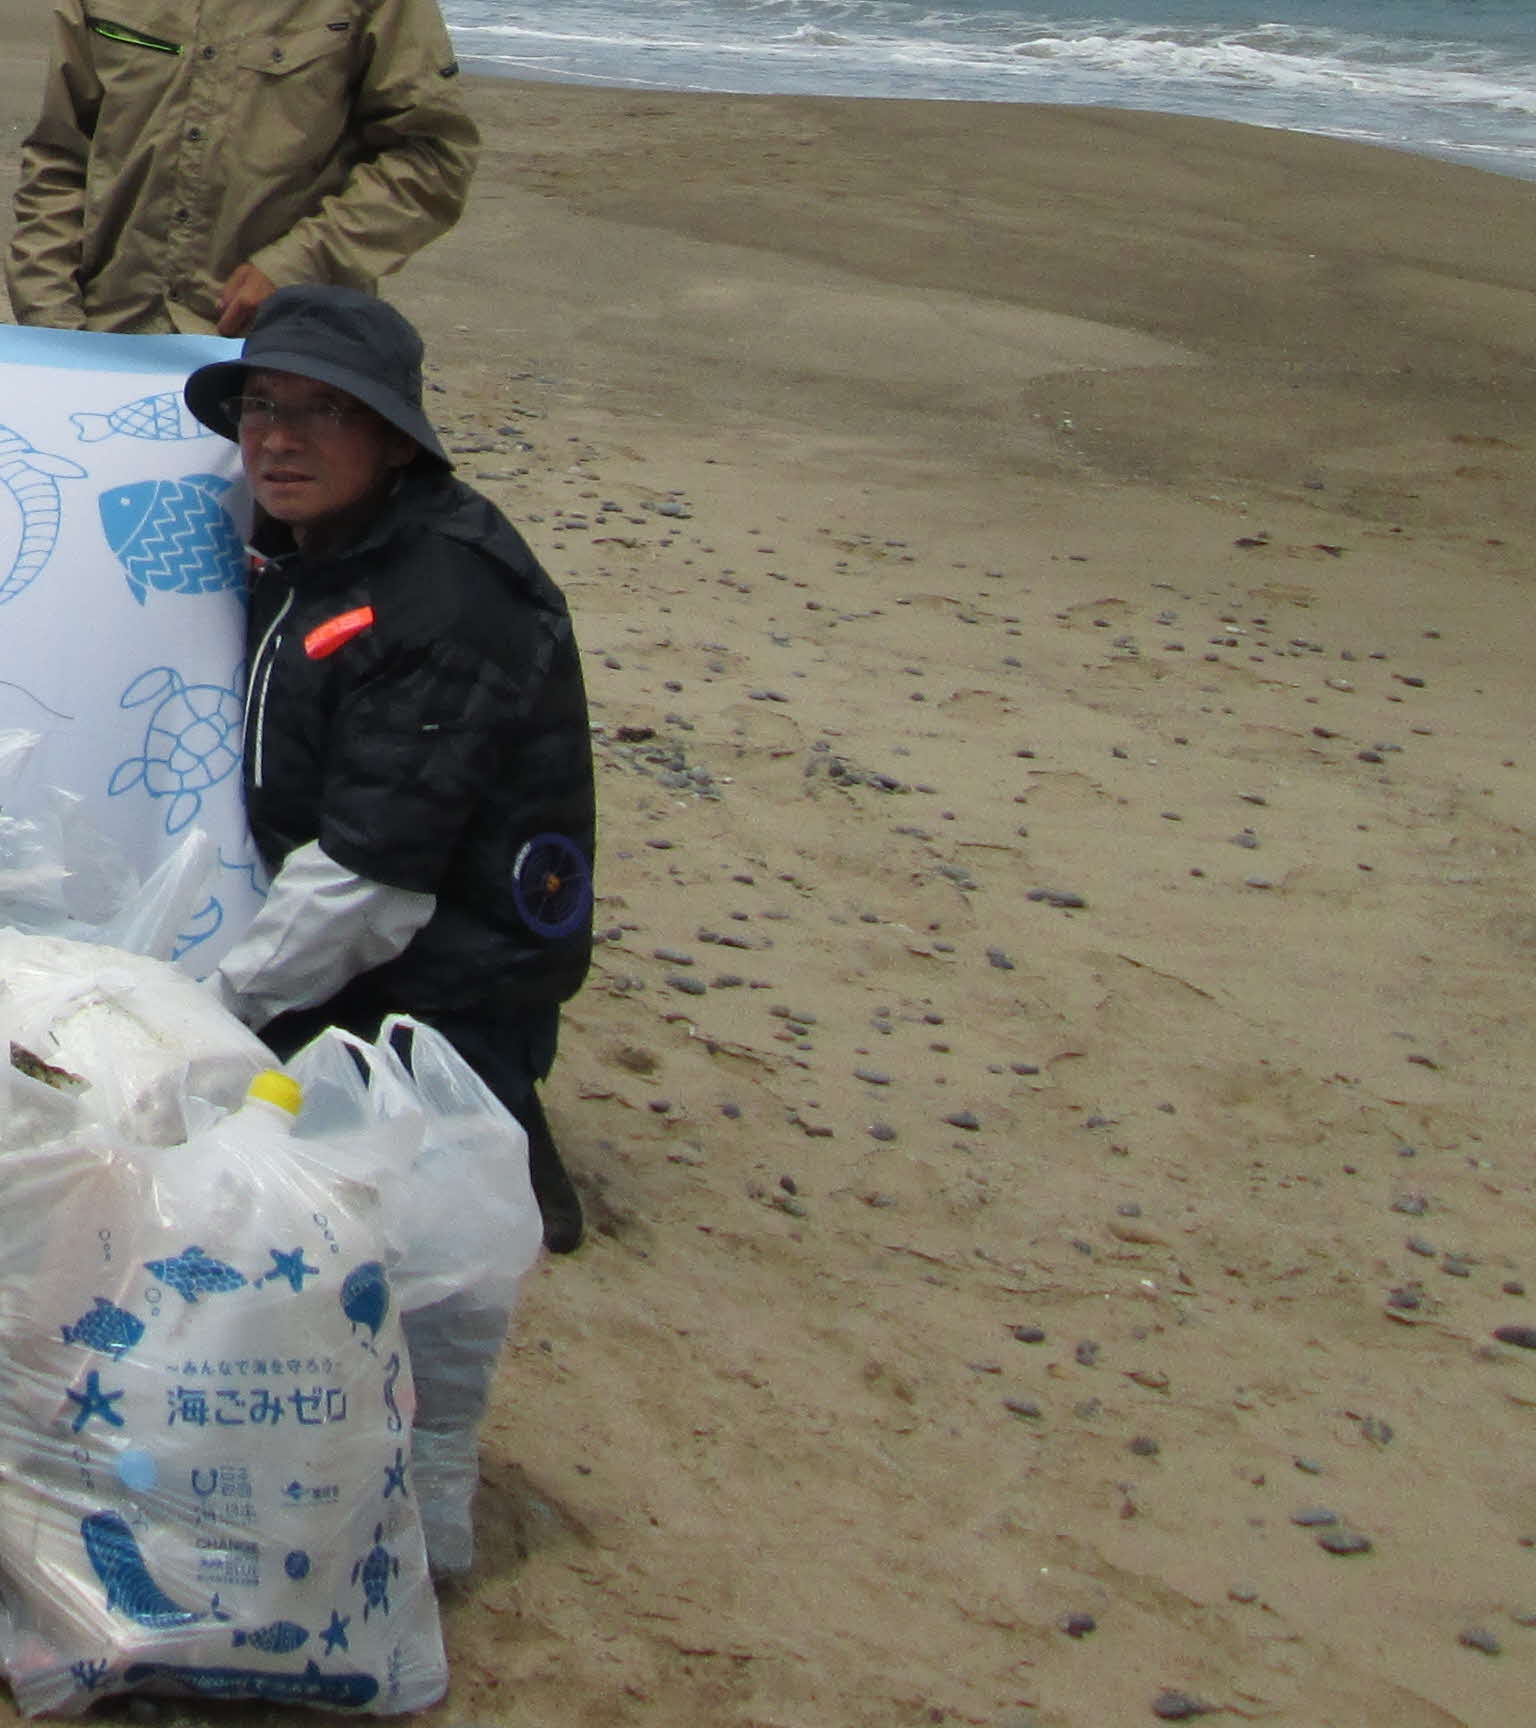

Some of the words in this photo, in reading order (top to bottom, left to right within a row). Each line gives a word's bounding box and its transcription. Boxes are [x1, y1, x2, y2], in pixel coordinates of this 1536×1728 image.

[167, 1384, 347, 1427] 海ごみゼロ
